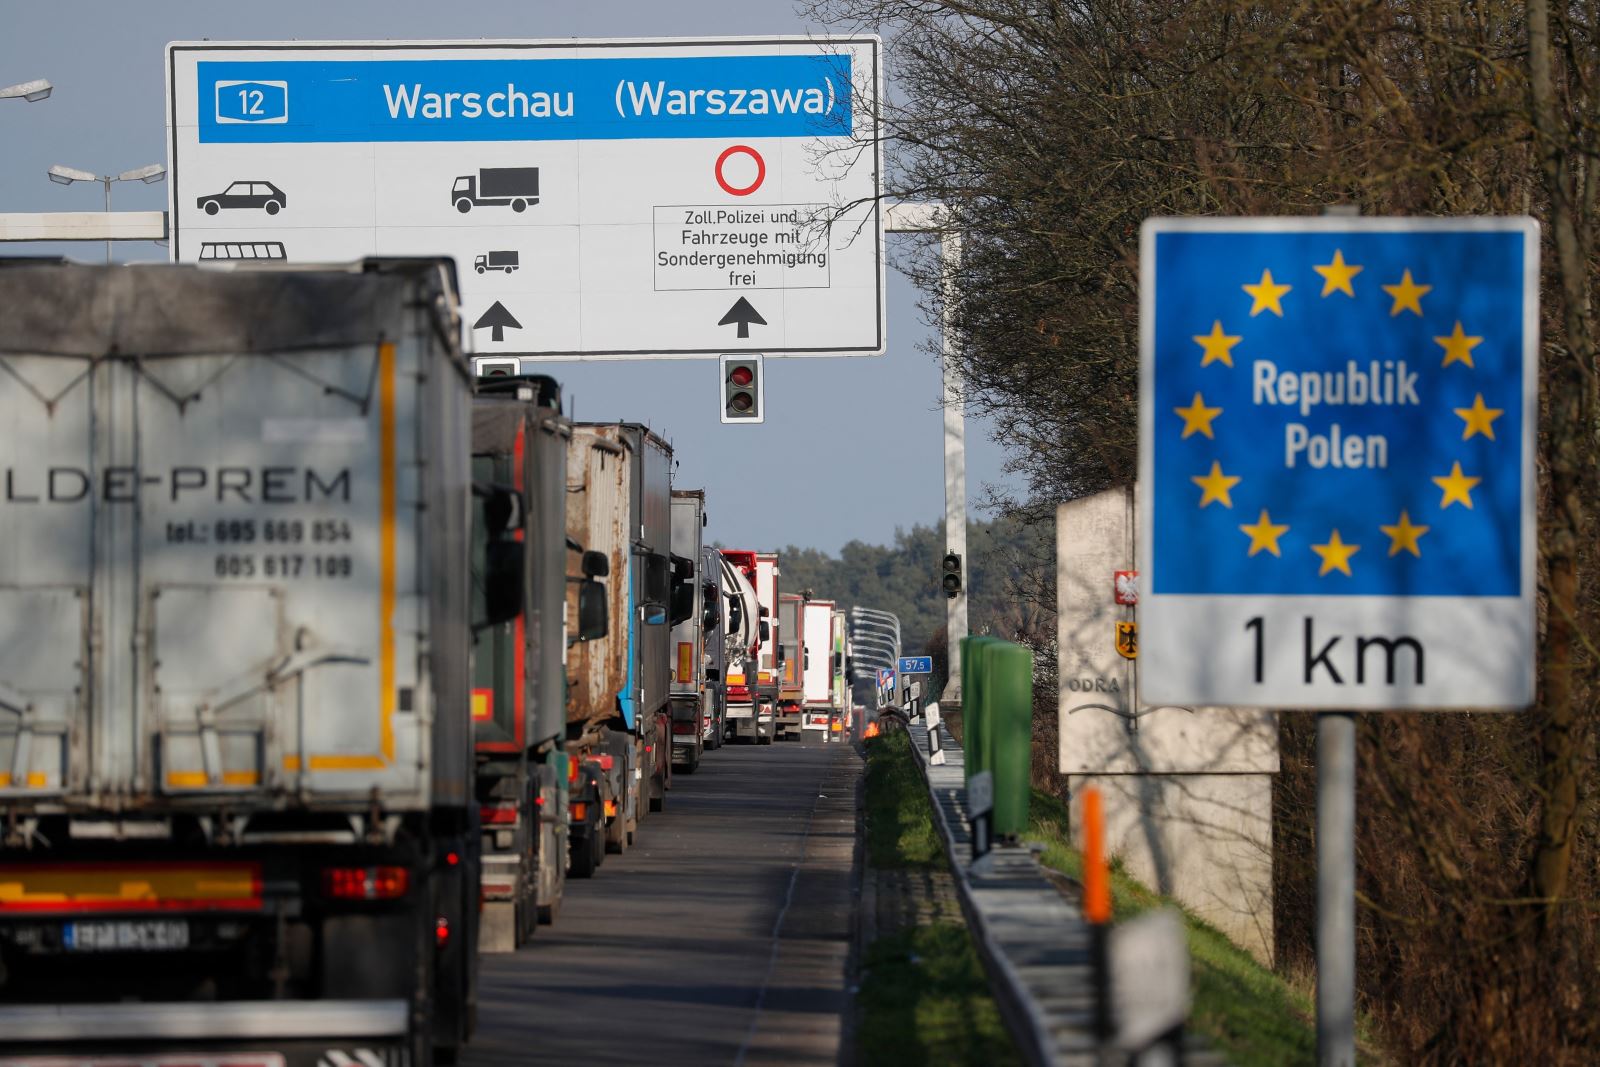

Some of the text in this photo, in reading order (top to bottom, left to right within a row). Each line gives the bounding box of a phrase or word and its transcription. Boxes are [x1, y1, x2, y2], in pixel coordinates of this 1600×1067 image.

[238, 90, 264, 114] 12
[383, 76, 835, 119] Warschau (Warszawa)
[771, 210, 797, 223] und
[682, 229, 801, 247] Fahrzeuge mit
[658, 250, 826, 269] Sondergenehmigung
[729, 270, 756, 285] frei
[1253, 360, 1420, 416] Republik
[1285, 423, 1388, 469] Polen
[1245, 616, 1425, 685] 1 km
[1069, 677, 1120, 692] ODRA
